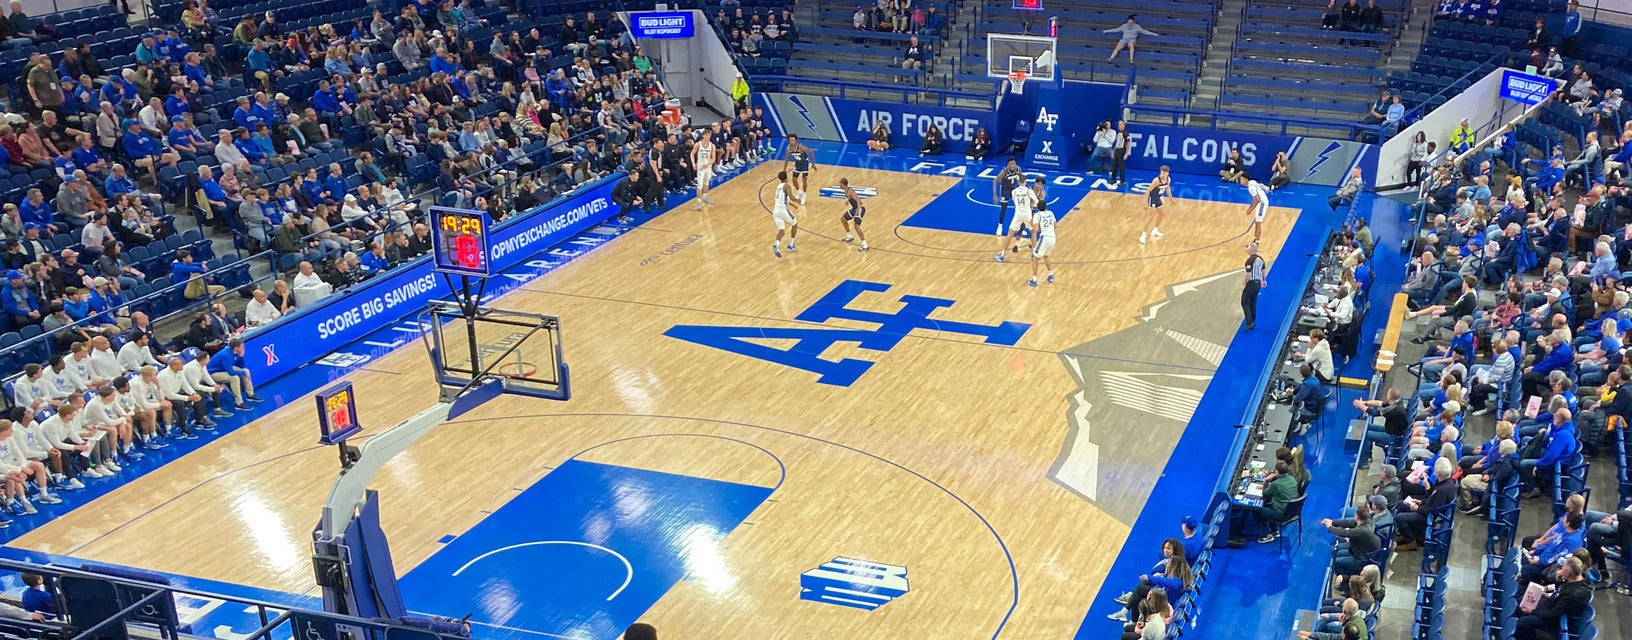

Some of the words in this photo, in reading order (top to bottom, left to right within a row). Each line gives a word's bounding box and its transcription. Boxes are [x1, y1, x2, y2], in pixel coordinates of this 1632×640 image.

[641, 18, 659, 27] BUD
[659, 17, 683, 27] LIGHT
[1509, 78, 1525, 90] BUD
[857, 109, 893, 134] AIR
[902, 113, 979, 142] FORCE
[1036, 106, 1059, 131] AF
[1034, 153, 1059, 162] EXCHANGE
[1127, 132, 1257, 167] FALCONS
[443, 215, 481, 235] 19:29
[318, 305, 362, 339] SCORE
[362, 297, 383, 317] BIG
[384, 272, 437, 309] SAVINGS!
